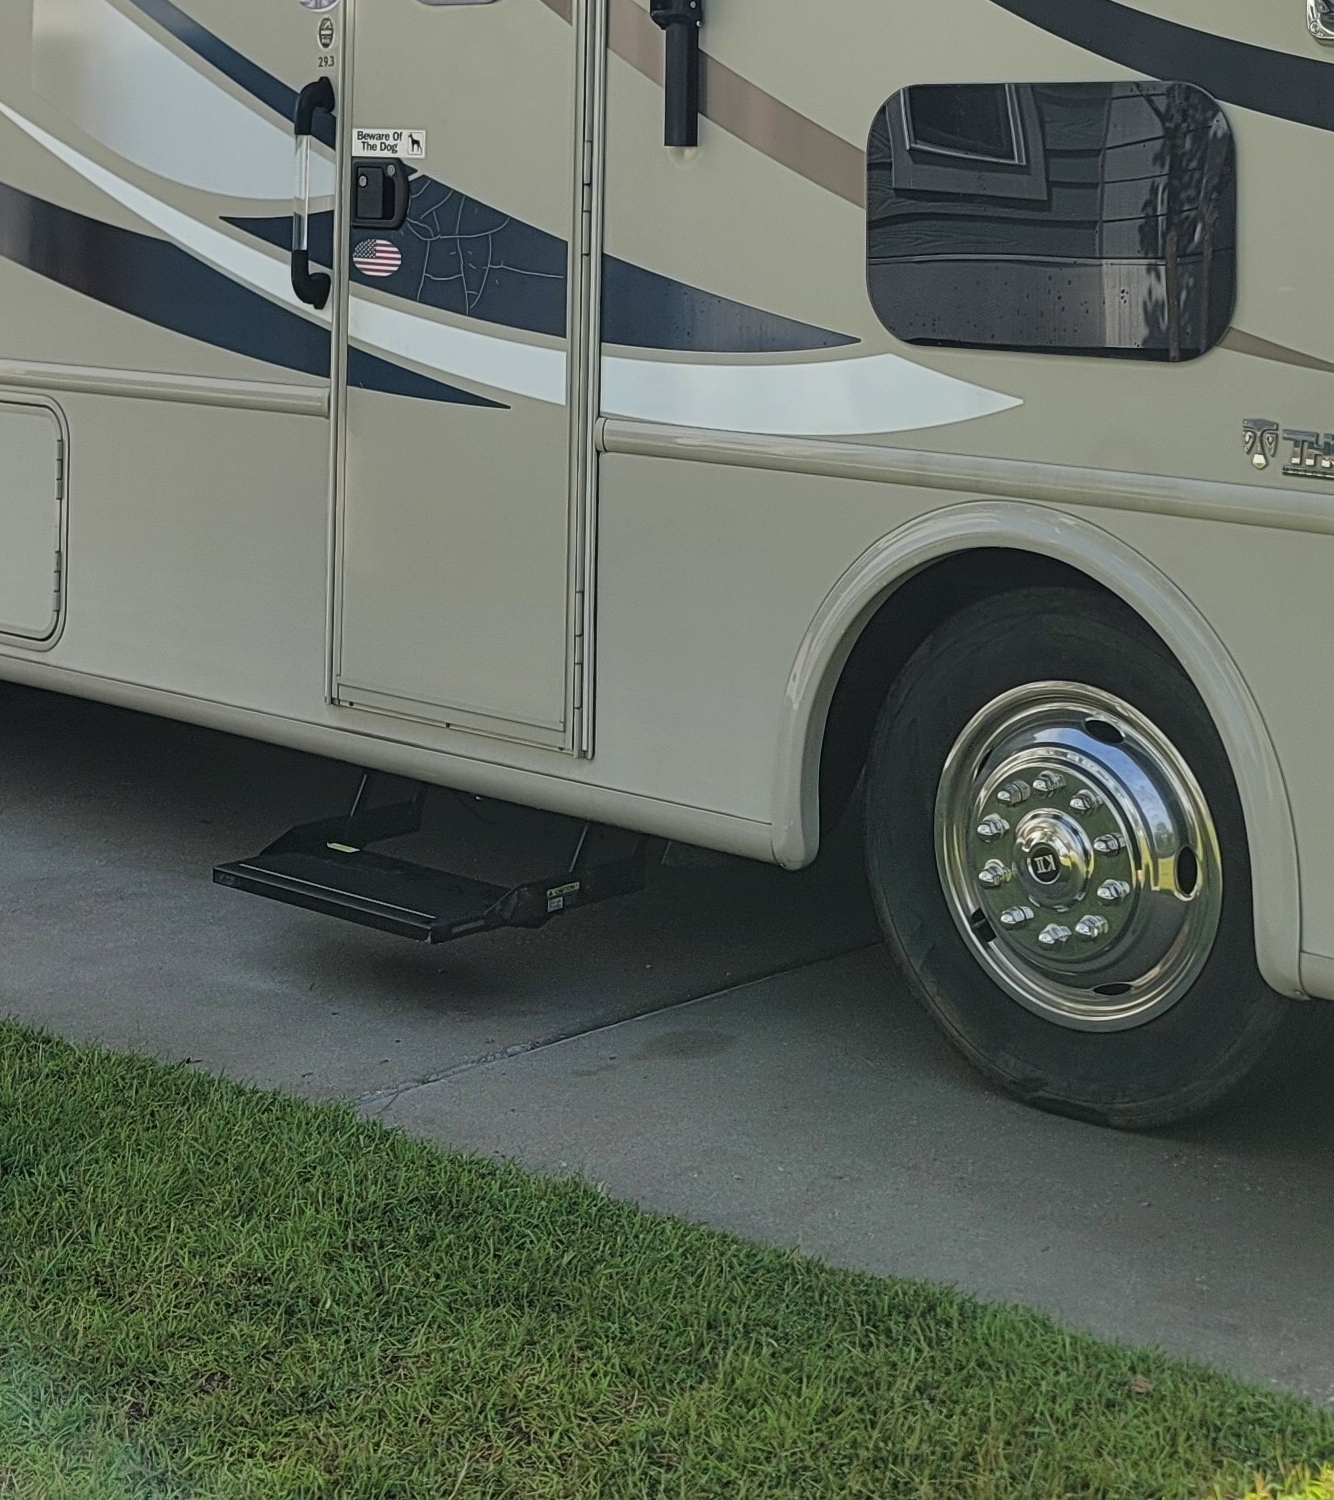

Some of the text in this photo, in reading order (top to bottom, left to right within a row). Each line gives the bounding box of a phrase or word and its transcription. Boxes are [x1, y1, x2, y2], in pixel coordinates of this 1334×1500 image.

[357, 130, 403, 142] Beware Of
[361, 141, 398, 154] The Dog
